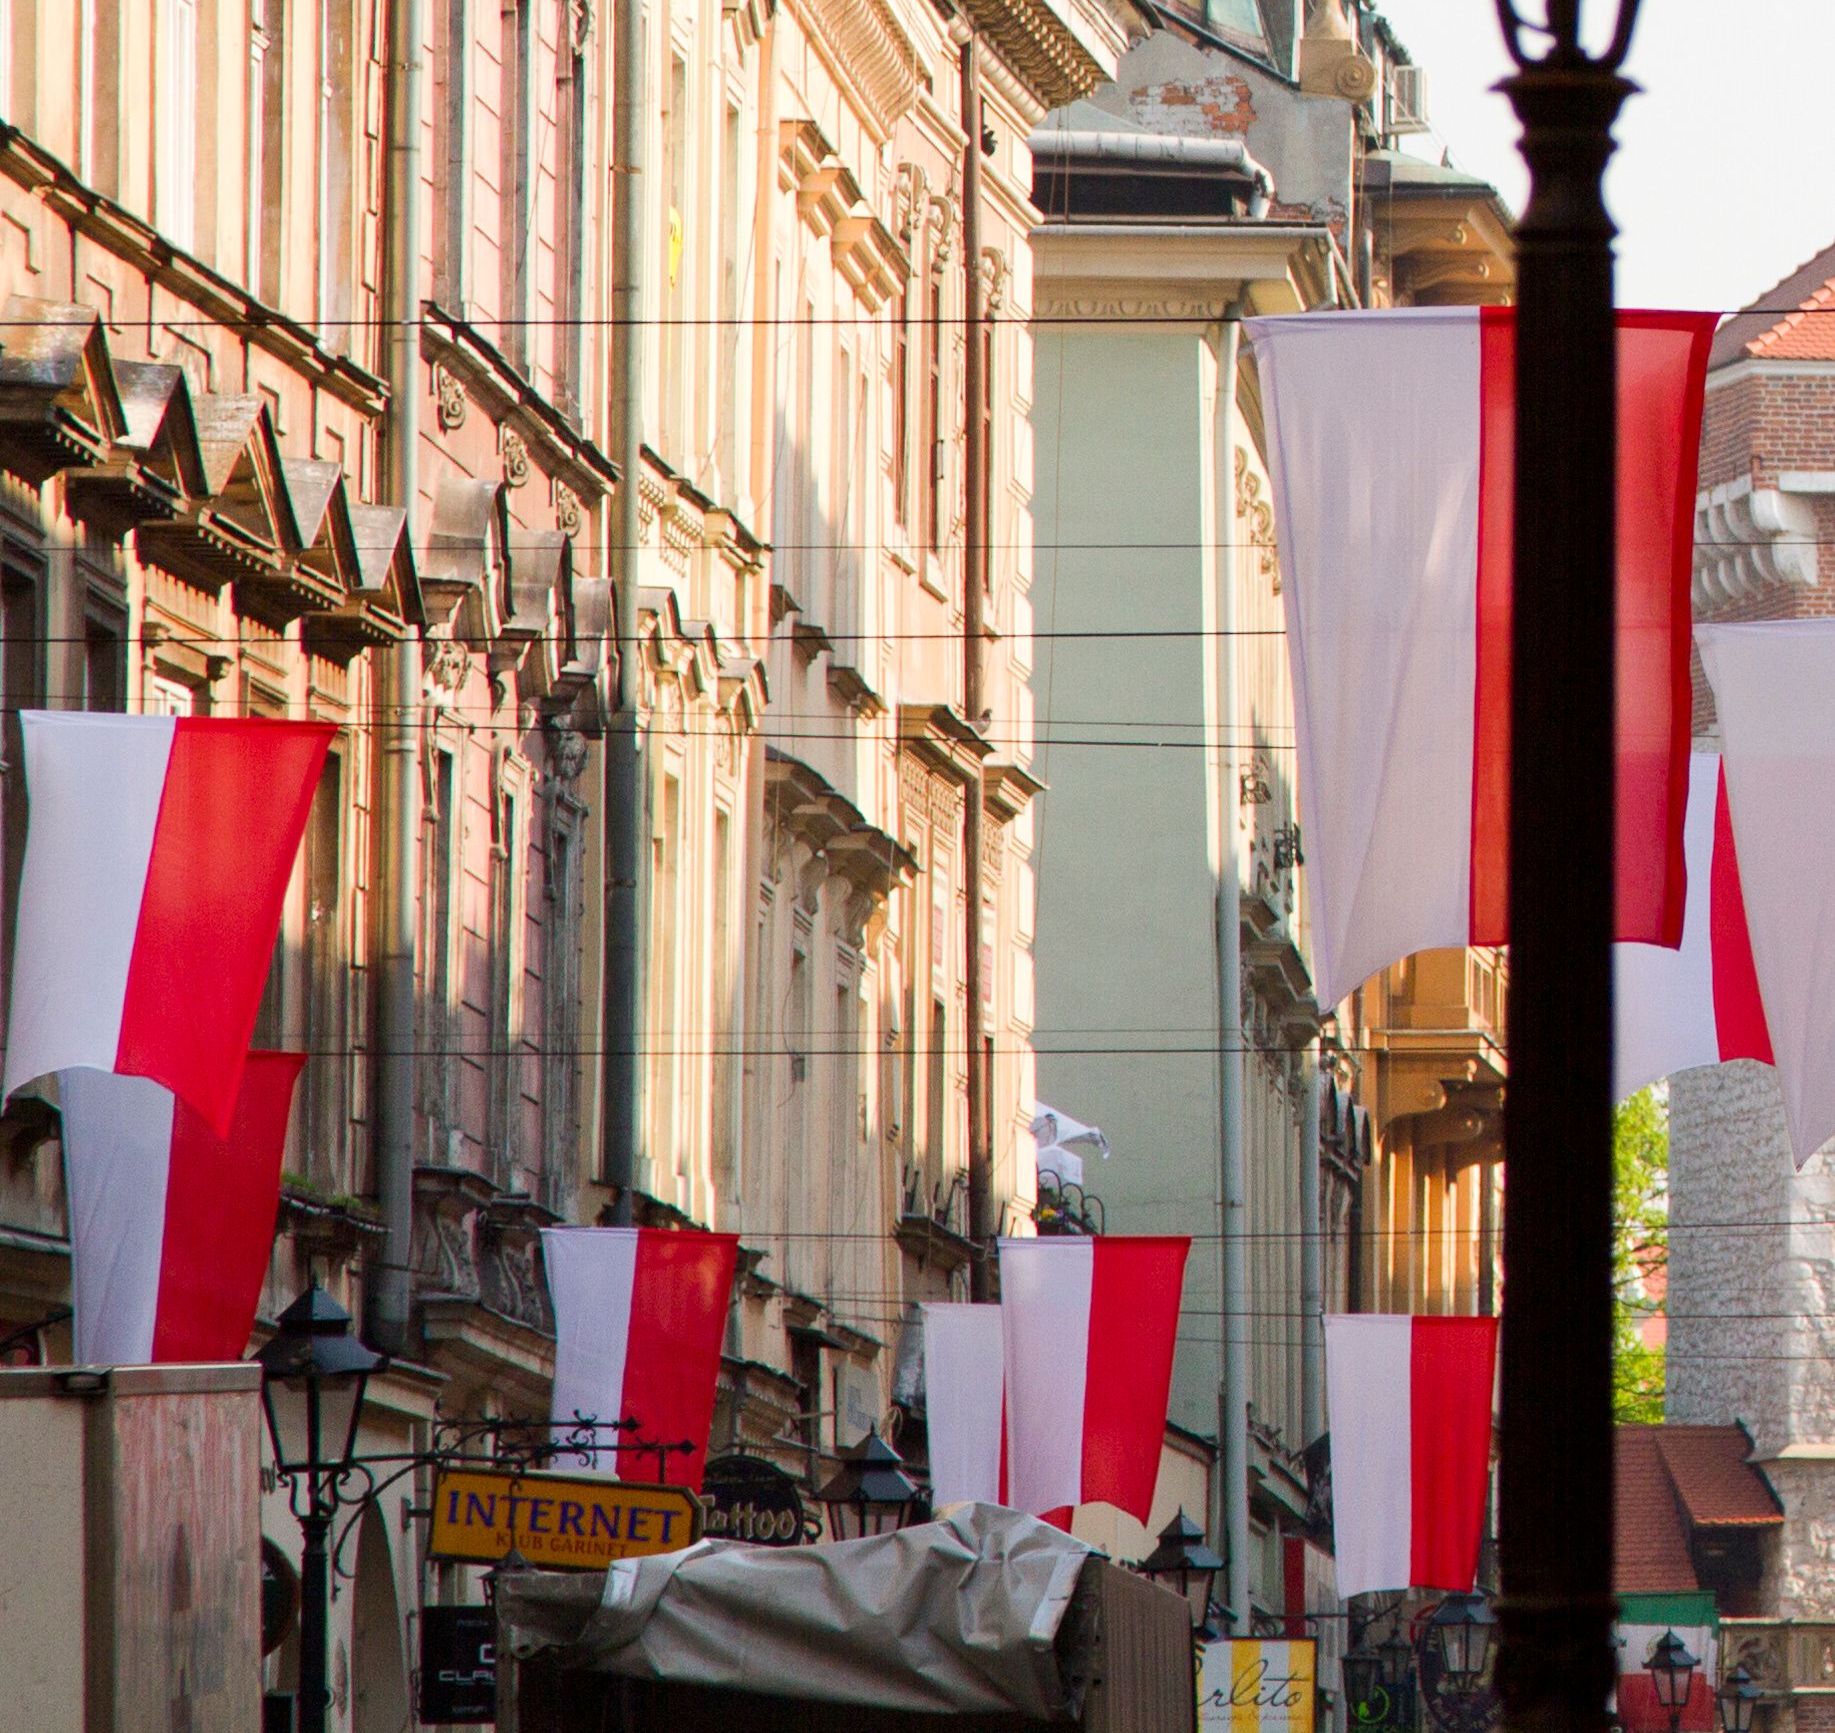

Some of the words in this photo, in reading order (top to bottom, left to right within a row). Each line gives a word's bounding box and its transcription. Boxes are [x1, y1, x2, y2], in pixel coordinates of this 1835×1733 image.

[447, 1489, 682, 1544] INTERNET
[496, 1532, 543, 1550] KUB
[1195, 1656, 1312, 1707] rlito
